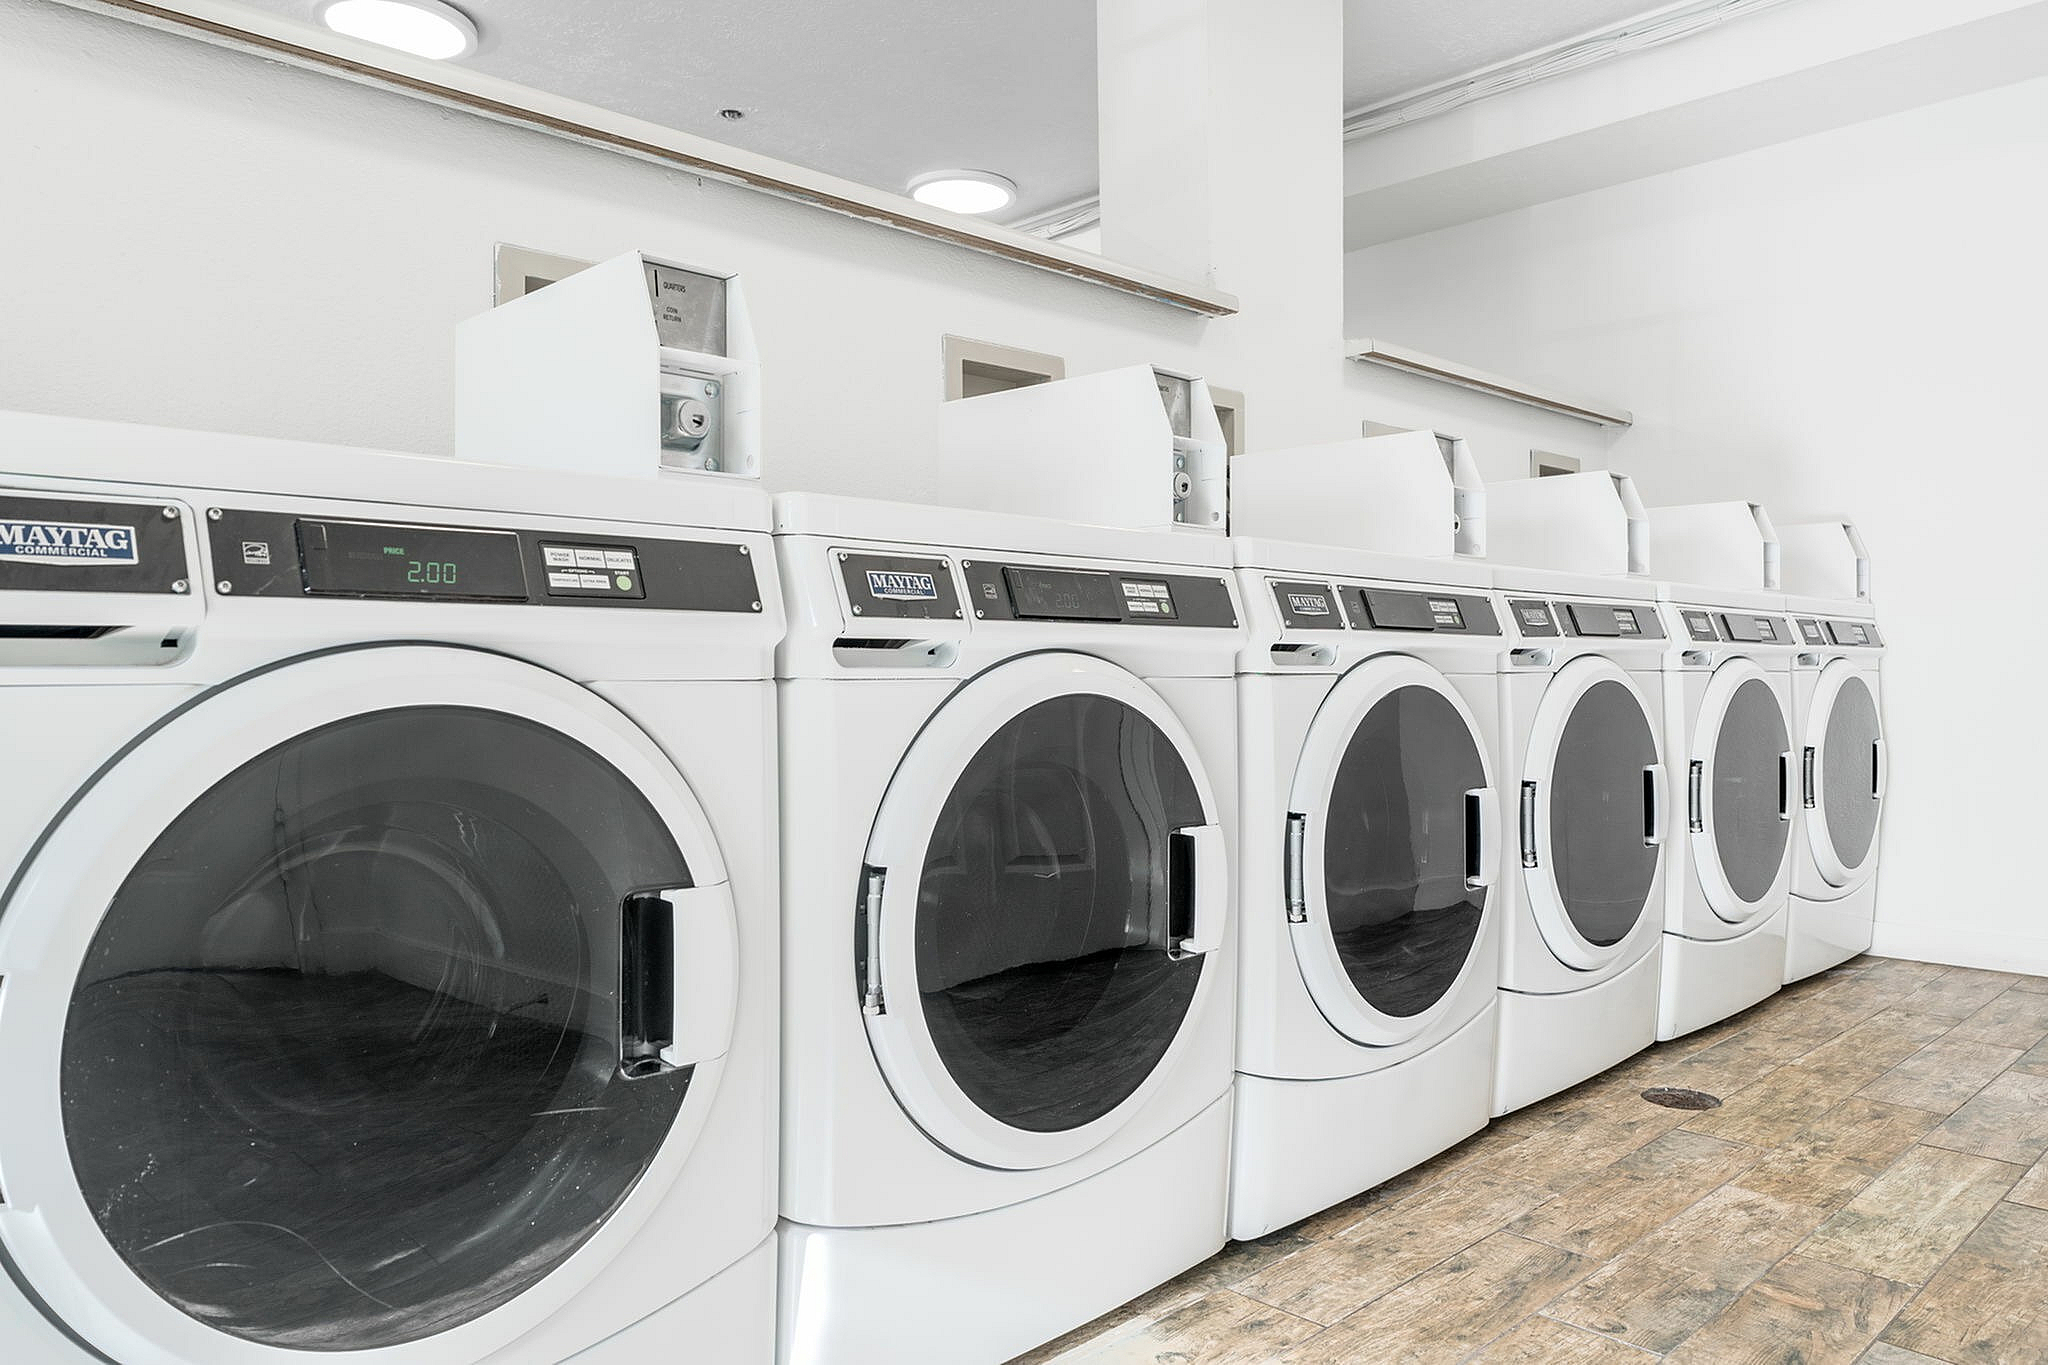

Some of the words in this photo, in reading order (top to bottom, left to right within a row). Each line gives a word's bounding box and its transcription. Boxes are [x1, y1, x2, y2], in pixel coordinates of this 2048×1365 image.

[0, 525, 128, 550] MAYTAG
[15, 546, 107, 557] COMMERCIAL
[383, 546, 405, 556] PRICE
[407, 561, 457, 584] 2.00
[870, 573, 932, 590] MAYTAG
[884, 587, 927, 595] COMMERCIAL
[1291, 597, 1326, 608] MAYTAG
